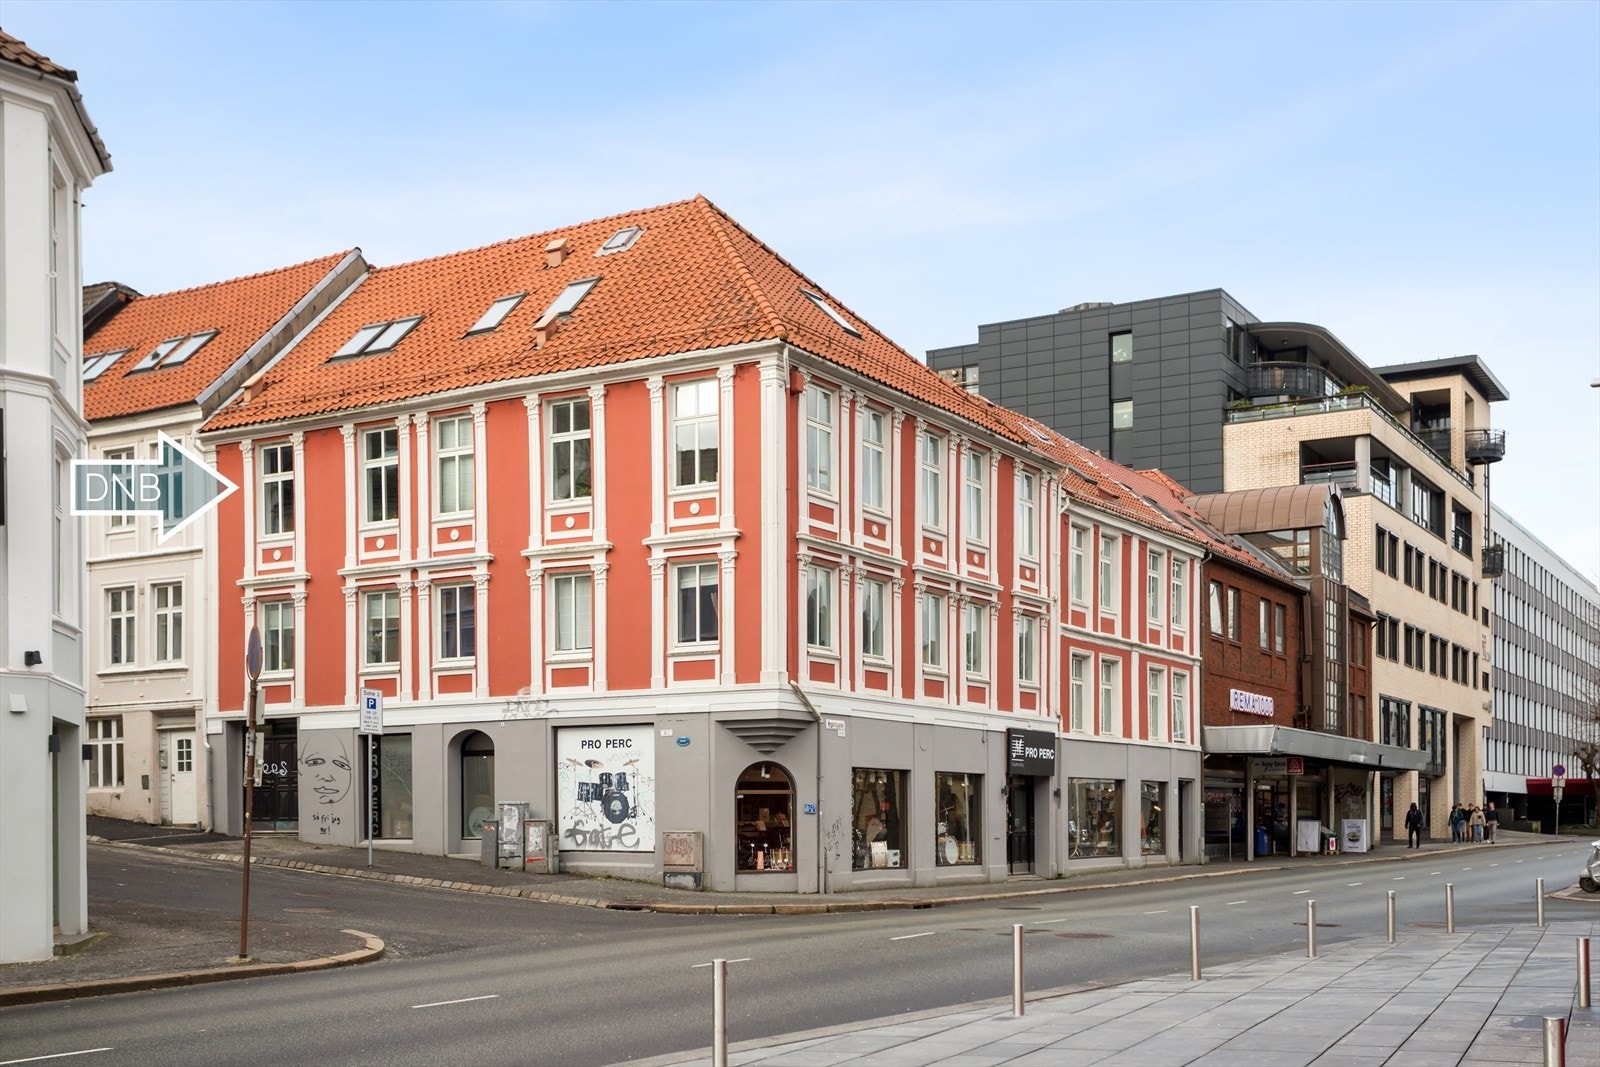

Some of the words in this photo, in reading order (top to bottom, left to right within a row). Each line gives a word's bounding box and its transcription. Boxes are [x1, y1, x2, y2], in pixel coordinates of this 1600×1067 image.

[1233, 691, 1255, 711] REMA
[581, 740, 601, 750] PRO
[605, 739, 632, 748] PERC
[1025, 747, 1038, 758] PRO
[1038, 748, 1055, 760] PERC
